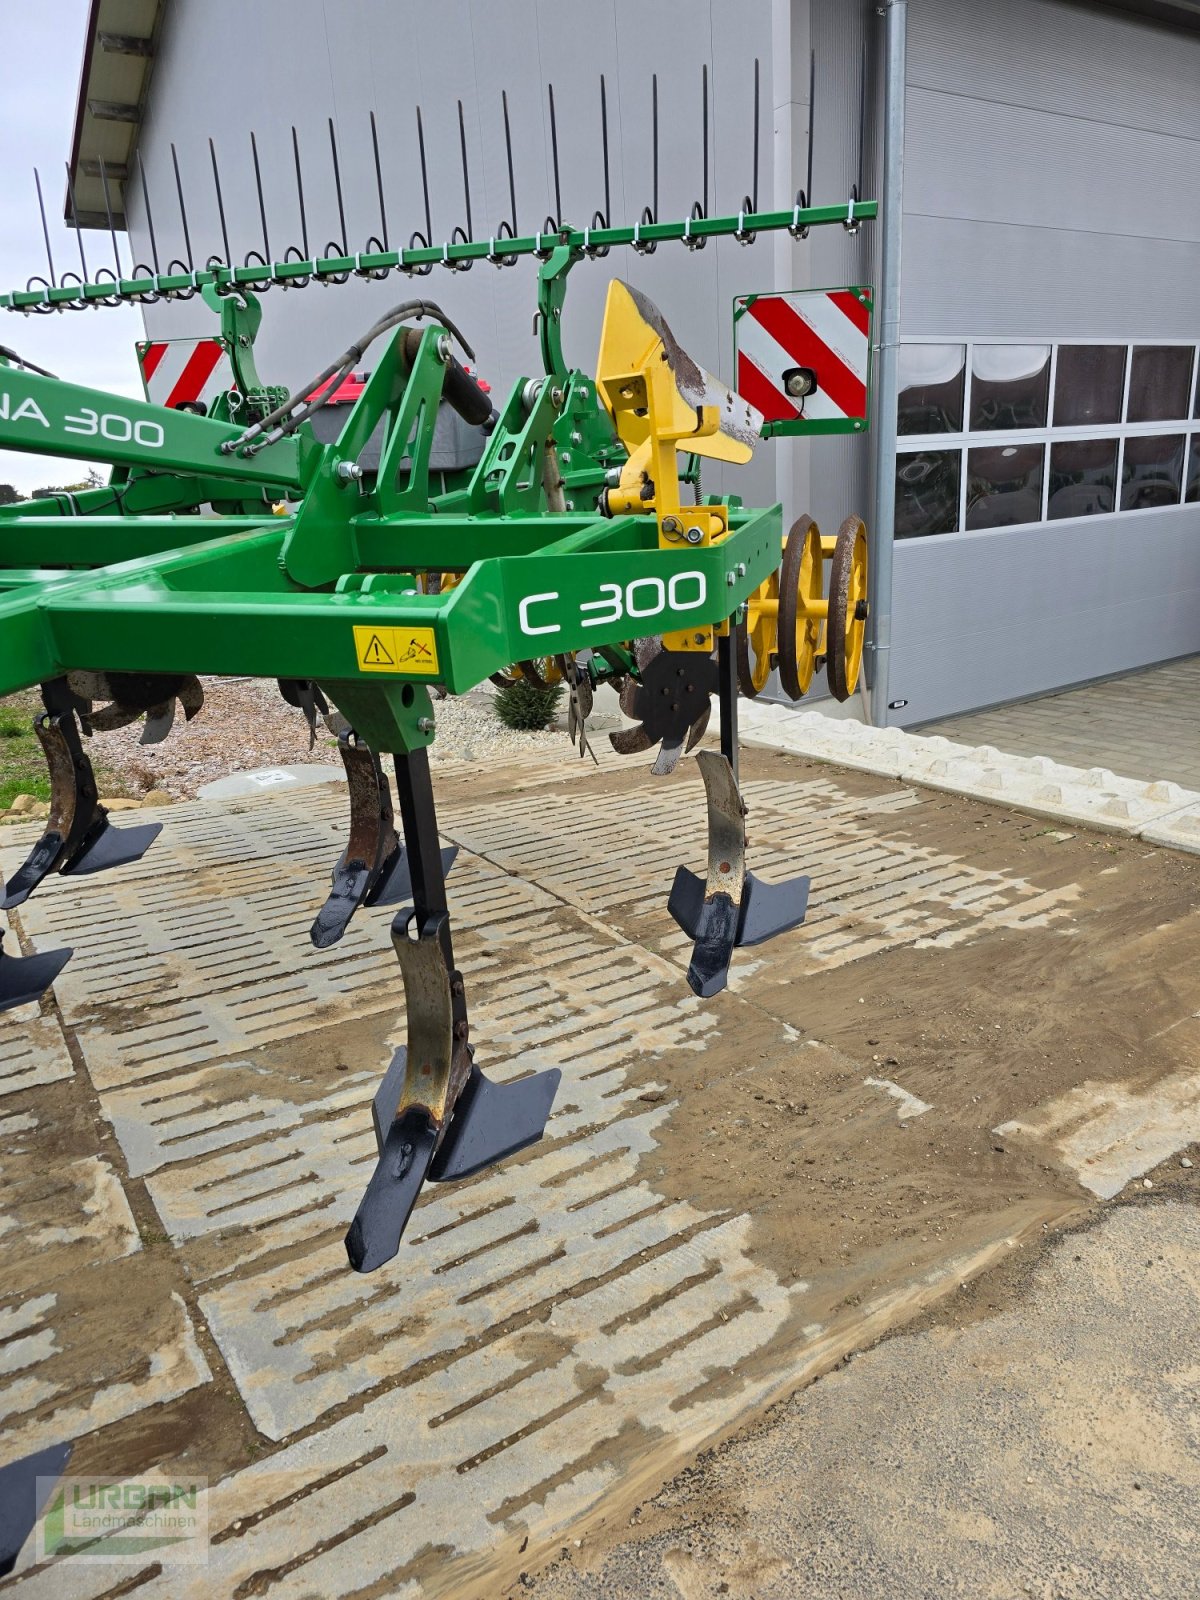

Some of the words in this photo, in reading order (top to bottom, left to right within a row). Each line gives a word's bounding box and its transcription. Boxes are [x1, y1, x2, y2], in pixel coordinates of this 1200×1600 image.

[64, 407, 164, 448] 300
[518, 591, 561, 635] C
[579, 570, 706, 628] 300
